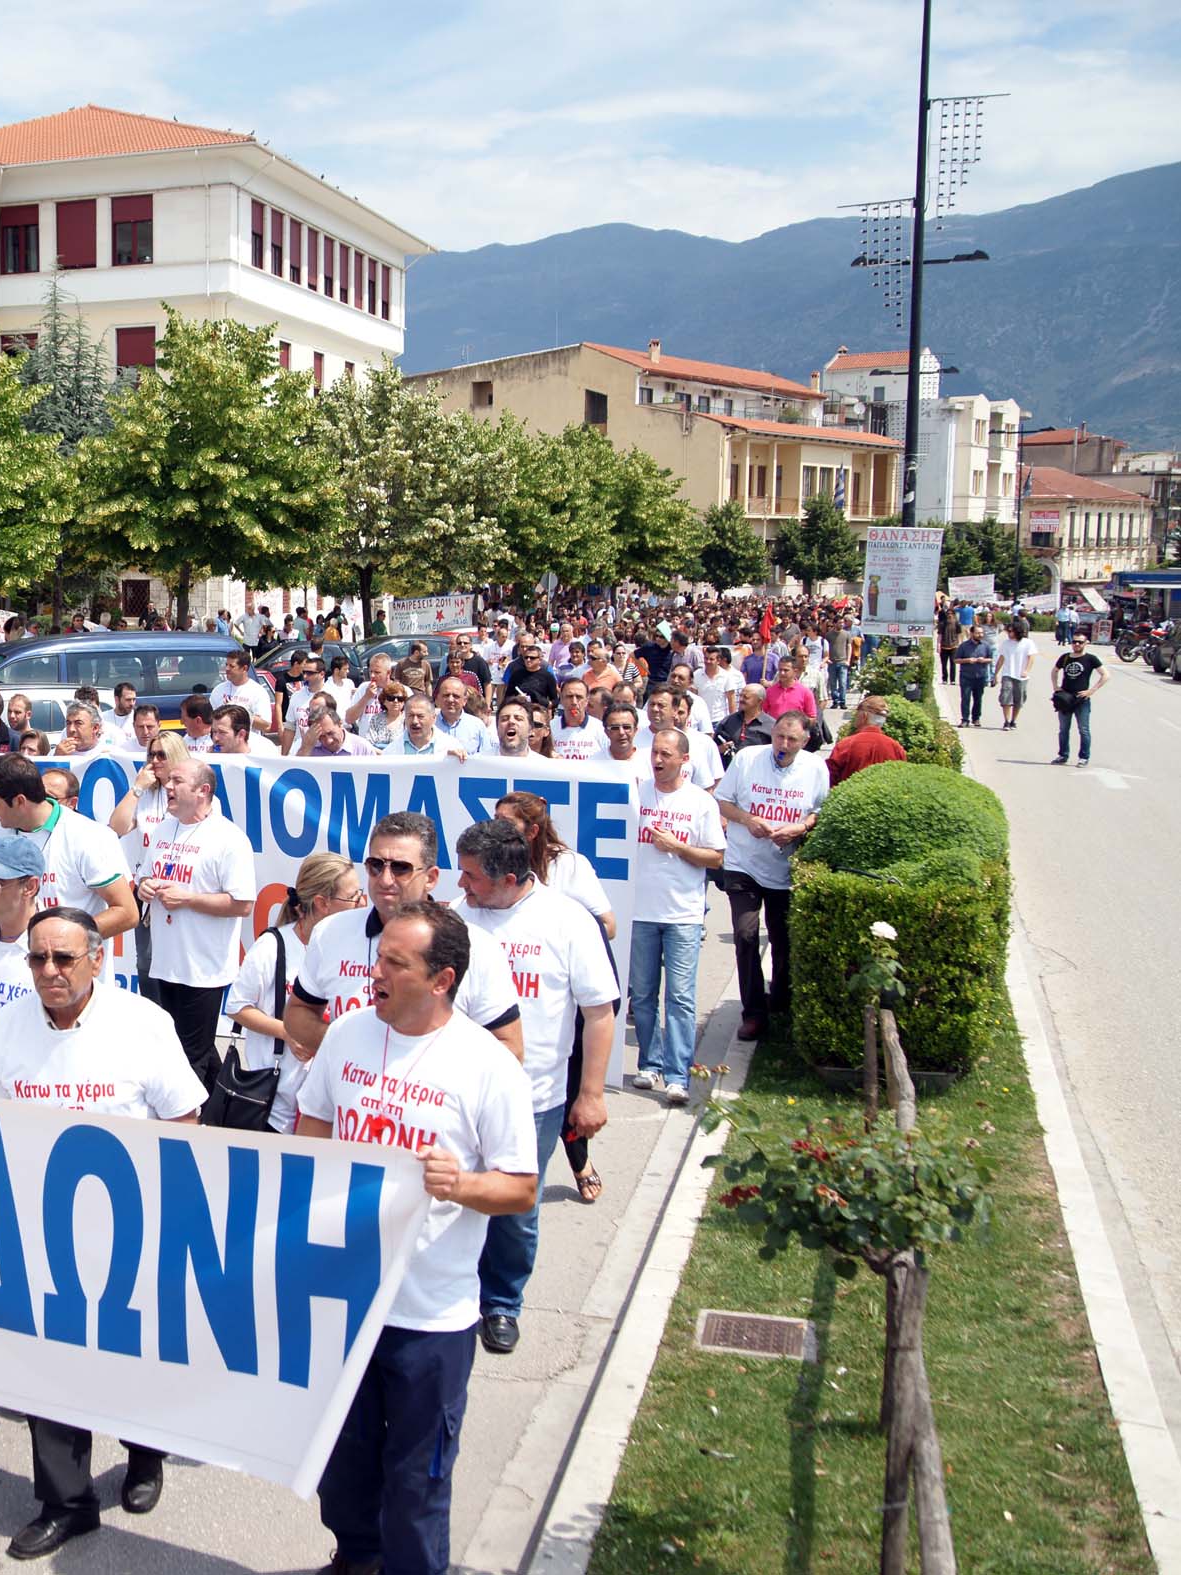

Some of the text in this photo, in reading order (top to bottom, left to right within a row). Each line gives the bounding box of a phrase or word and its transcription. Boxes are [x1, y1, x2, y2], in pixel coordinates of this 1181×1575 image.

[869, 529, 942, 542] ΘΑΝΑΣΗΣ
[749, 802, 802, 823] ΔΩΔΩΝΗ
[14, 1079, 115, 1102] Κάτω τα χέρια
[341, 1060, 446, 1106] Κάτω τα χέρια
[387, 1103, 403, 1121] τη
